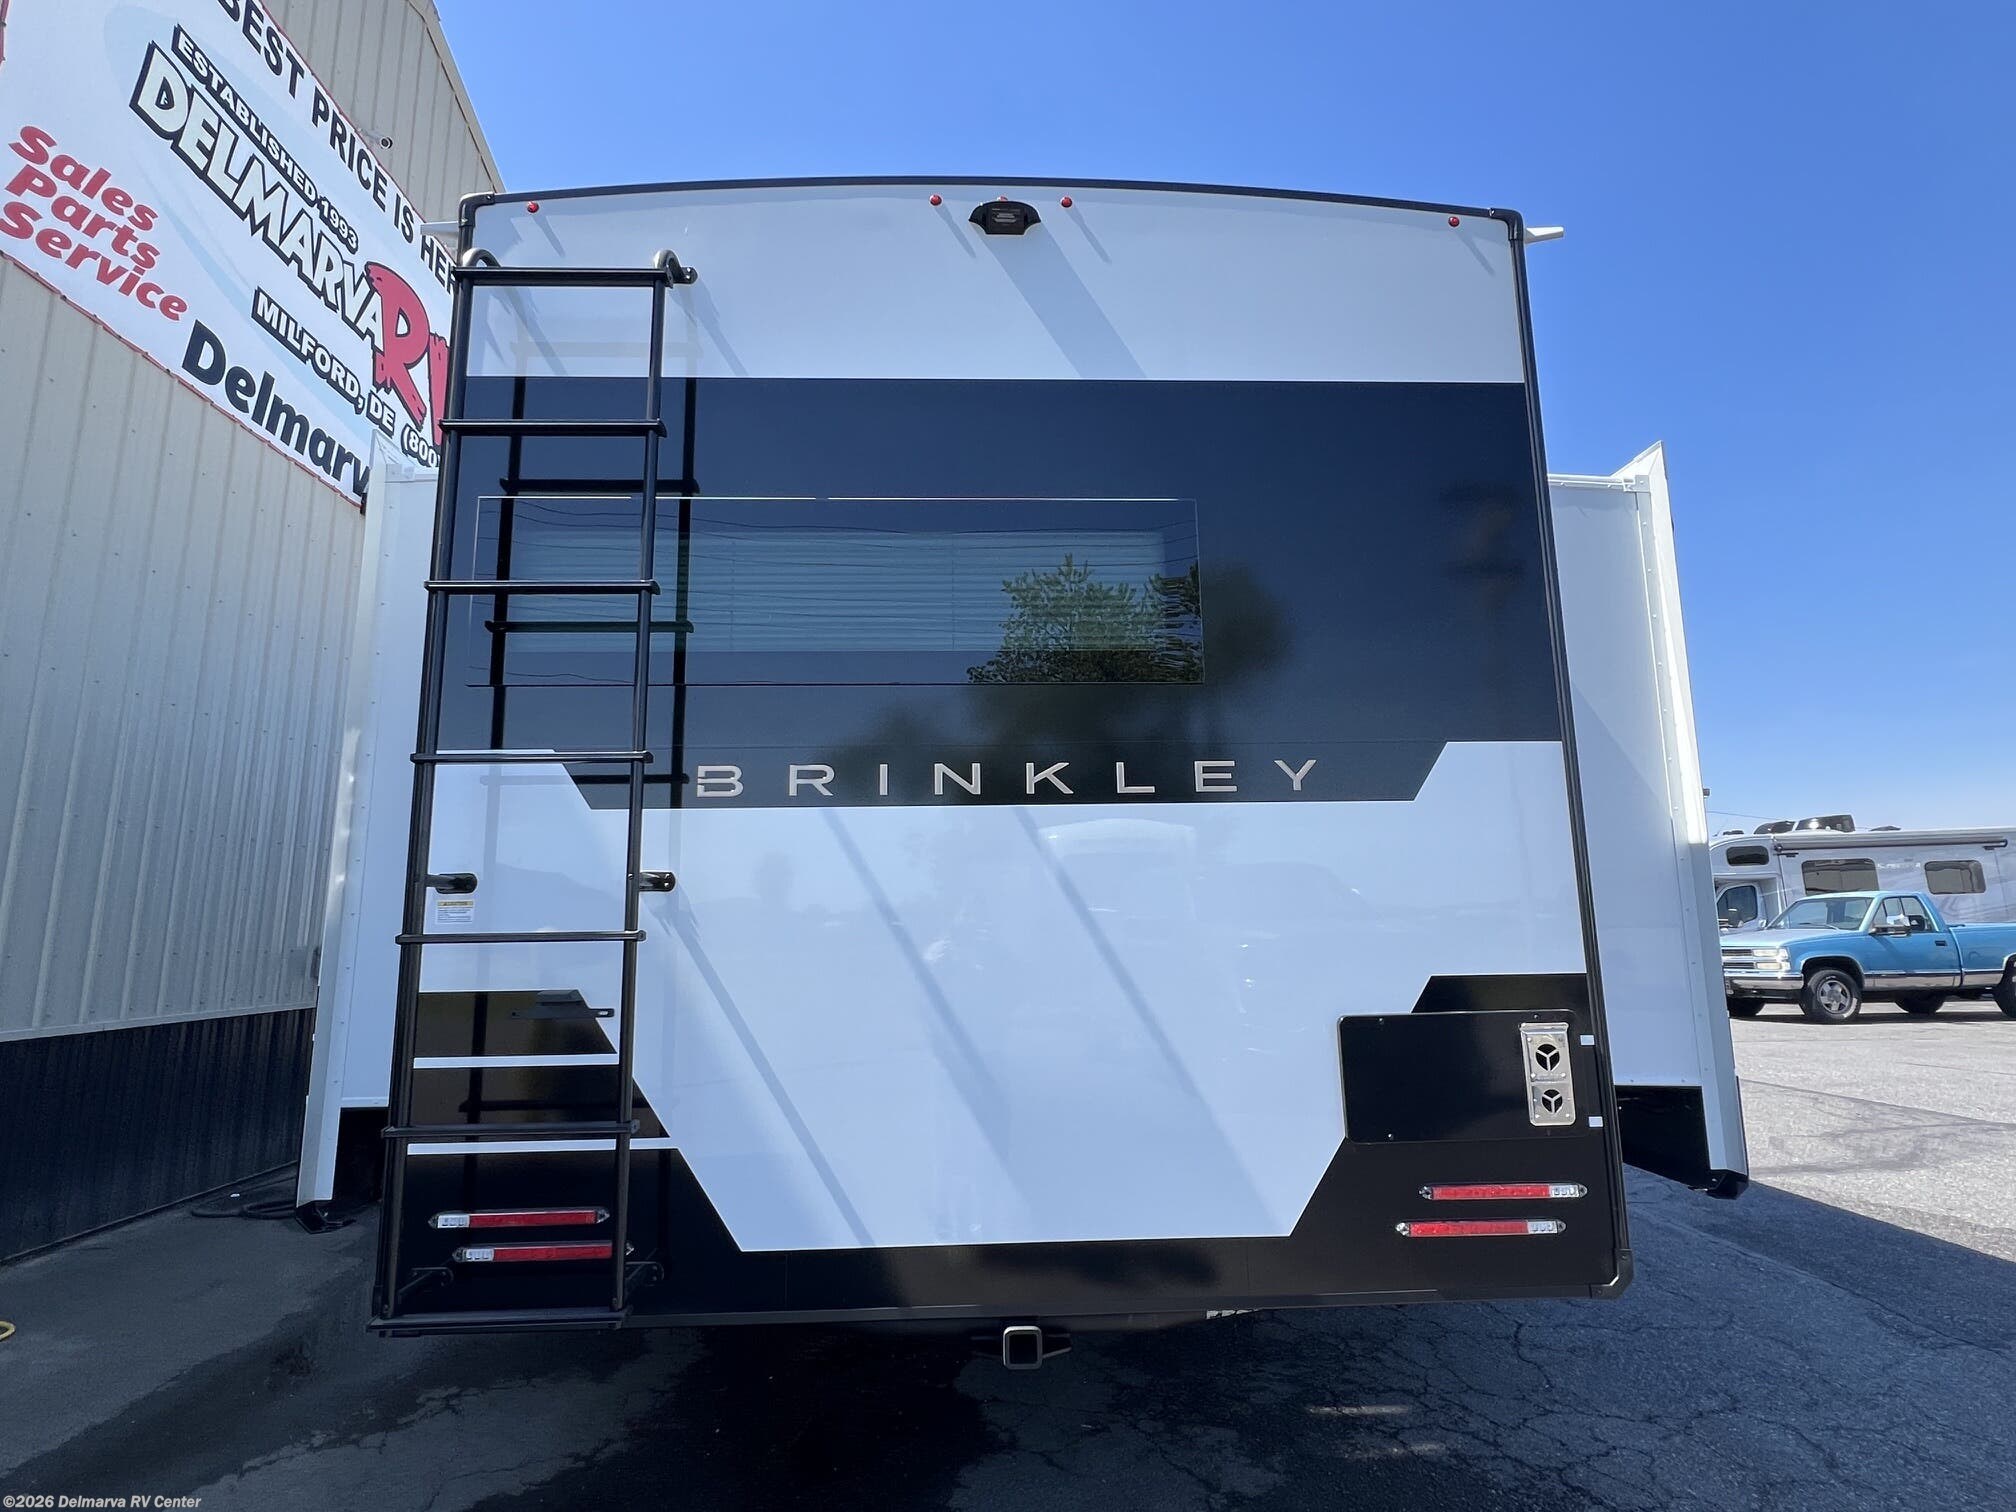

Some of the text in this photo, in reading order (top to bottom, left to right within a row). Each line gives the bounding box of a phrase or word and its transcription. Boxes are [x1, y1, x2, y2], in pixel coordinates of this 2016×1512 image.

[8, 126, 158, 231] Sales
[129, 40, 384, 353] DELMARVA
[173, 27, 358, 254] ESTABLISHED 1993
[312, 86, 388, 212] PRICE
[394, 193, 415, 244] IS
[0, 201, 188, 321] Service
[5, 164, 160, 269] Parts
[253, 288, 395, 438] MILFORD, DE
[697, 759, 1317, 798] BRINKLEY
